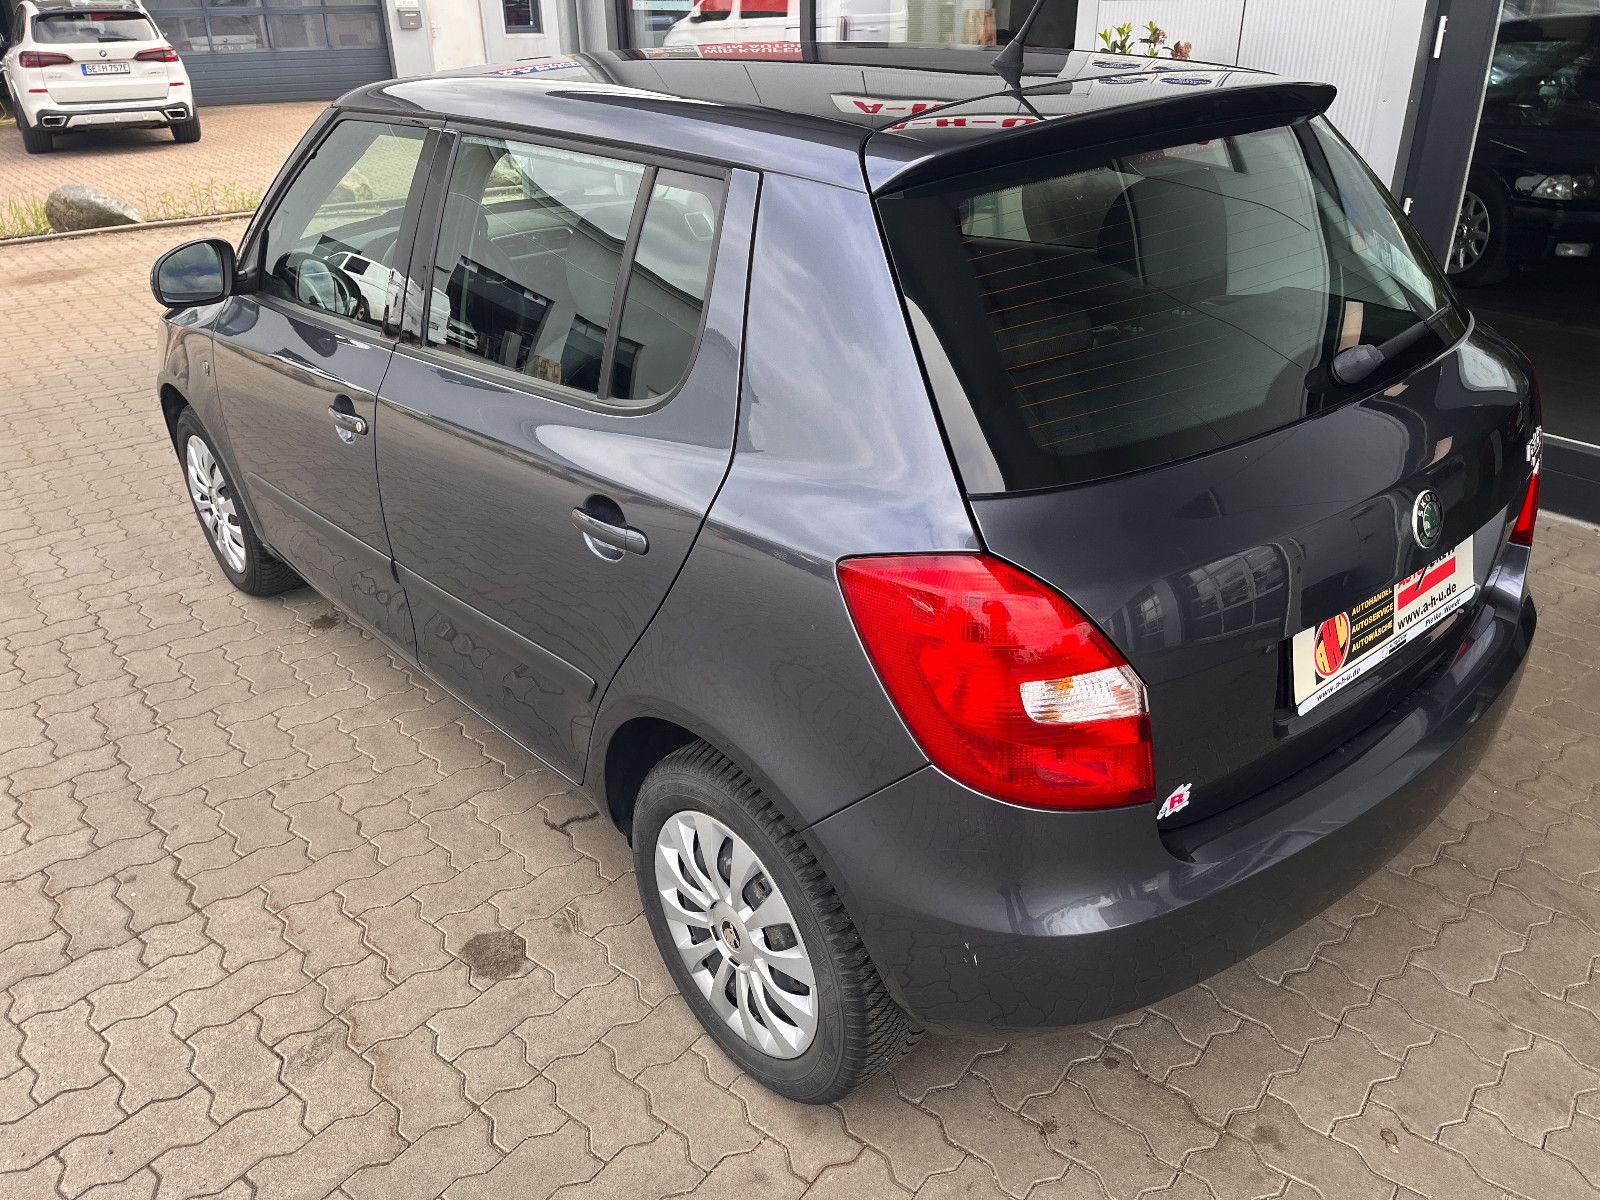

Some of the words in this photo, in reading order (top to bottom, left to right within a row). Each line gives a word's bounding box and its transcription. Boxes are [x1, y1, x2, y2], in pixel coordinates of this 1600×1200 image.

[1351, 587, 1393, 617] AUTOHANDEL
[1397, 583, 1457, 630] www.a-h-u.de
[1351, 602, 1394, 635] AUTOSERVICE
[1169, 793, 1184, 810] R
